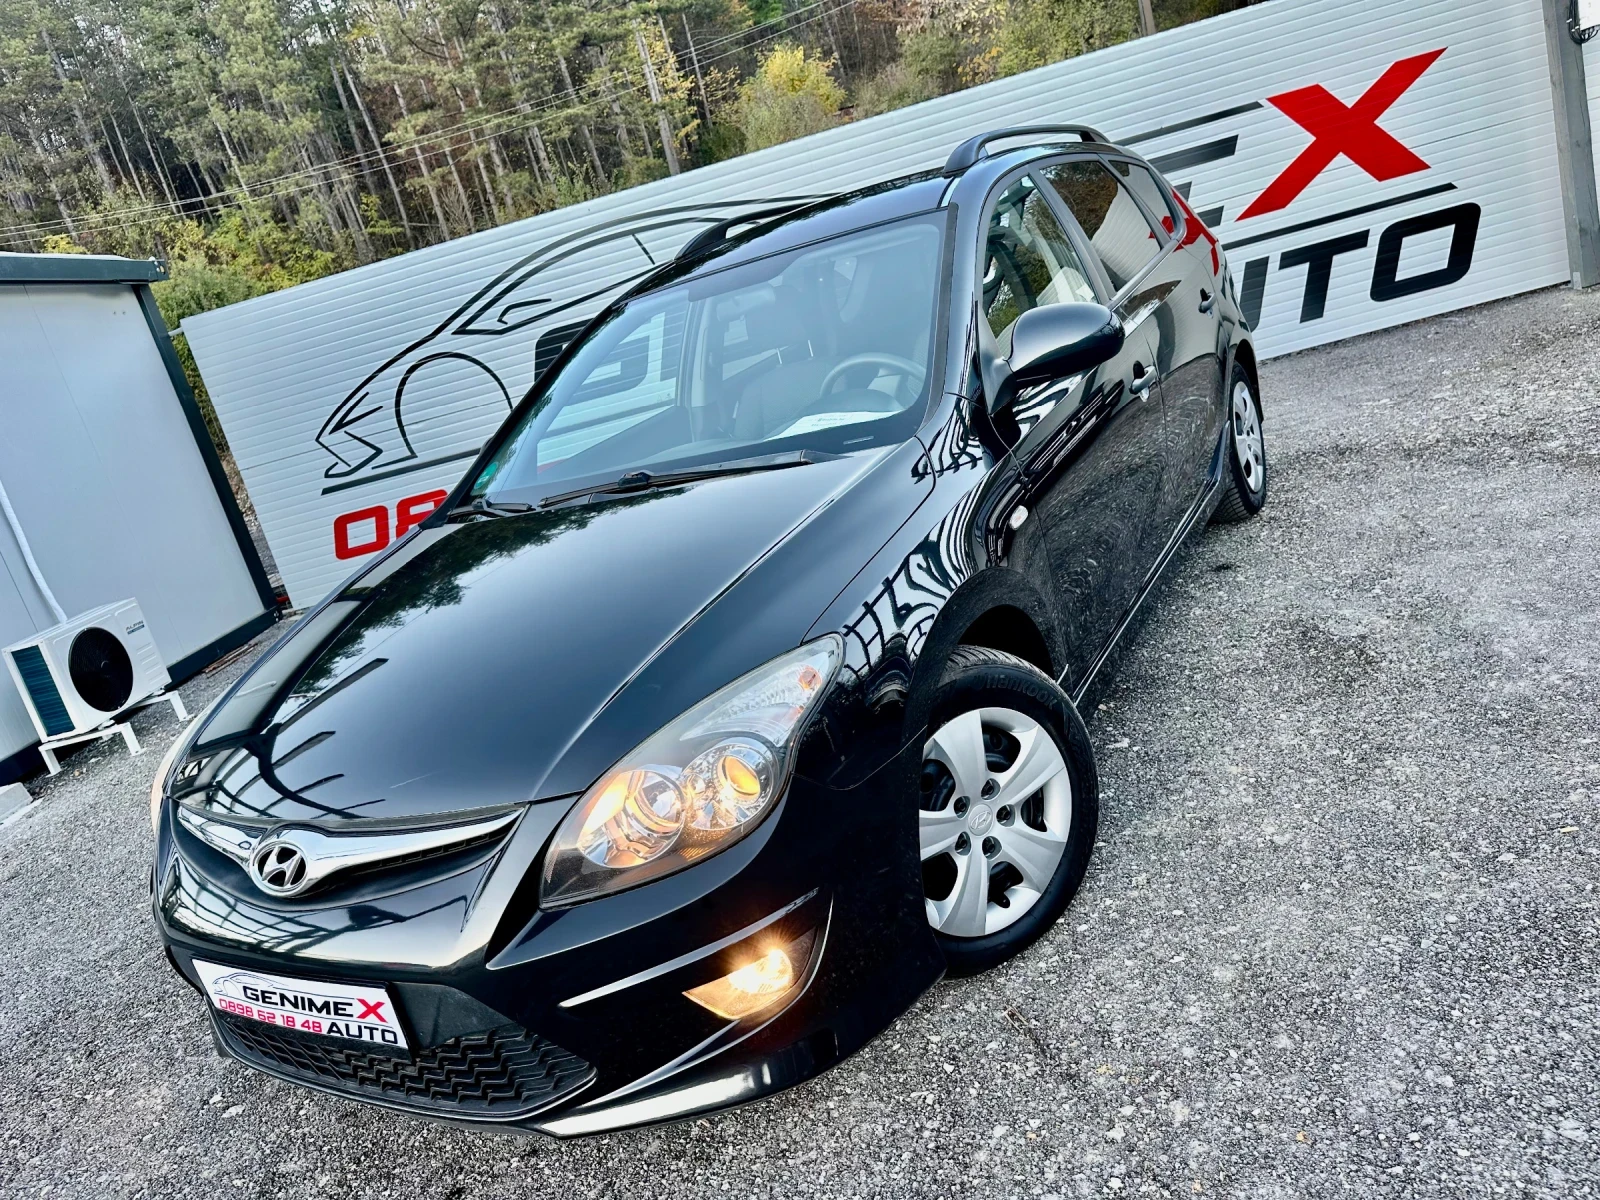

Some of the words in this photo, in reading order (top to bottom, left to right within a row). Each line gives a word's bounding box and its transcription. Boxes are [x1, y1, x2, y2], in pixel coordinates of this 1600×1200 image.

[219, 998, 254, 1018] 0898
[257, 1010, 277, 1024] 62
[282, 1014, 296, 1028] 18
[300, 1018, 323, 1034] 48
[243, 986, 388, 1023] GENIMEX
[326, 1022, 398, 1045] AUTO
